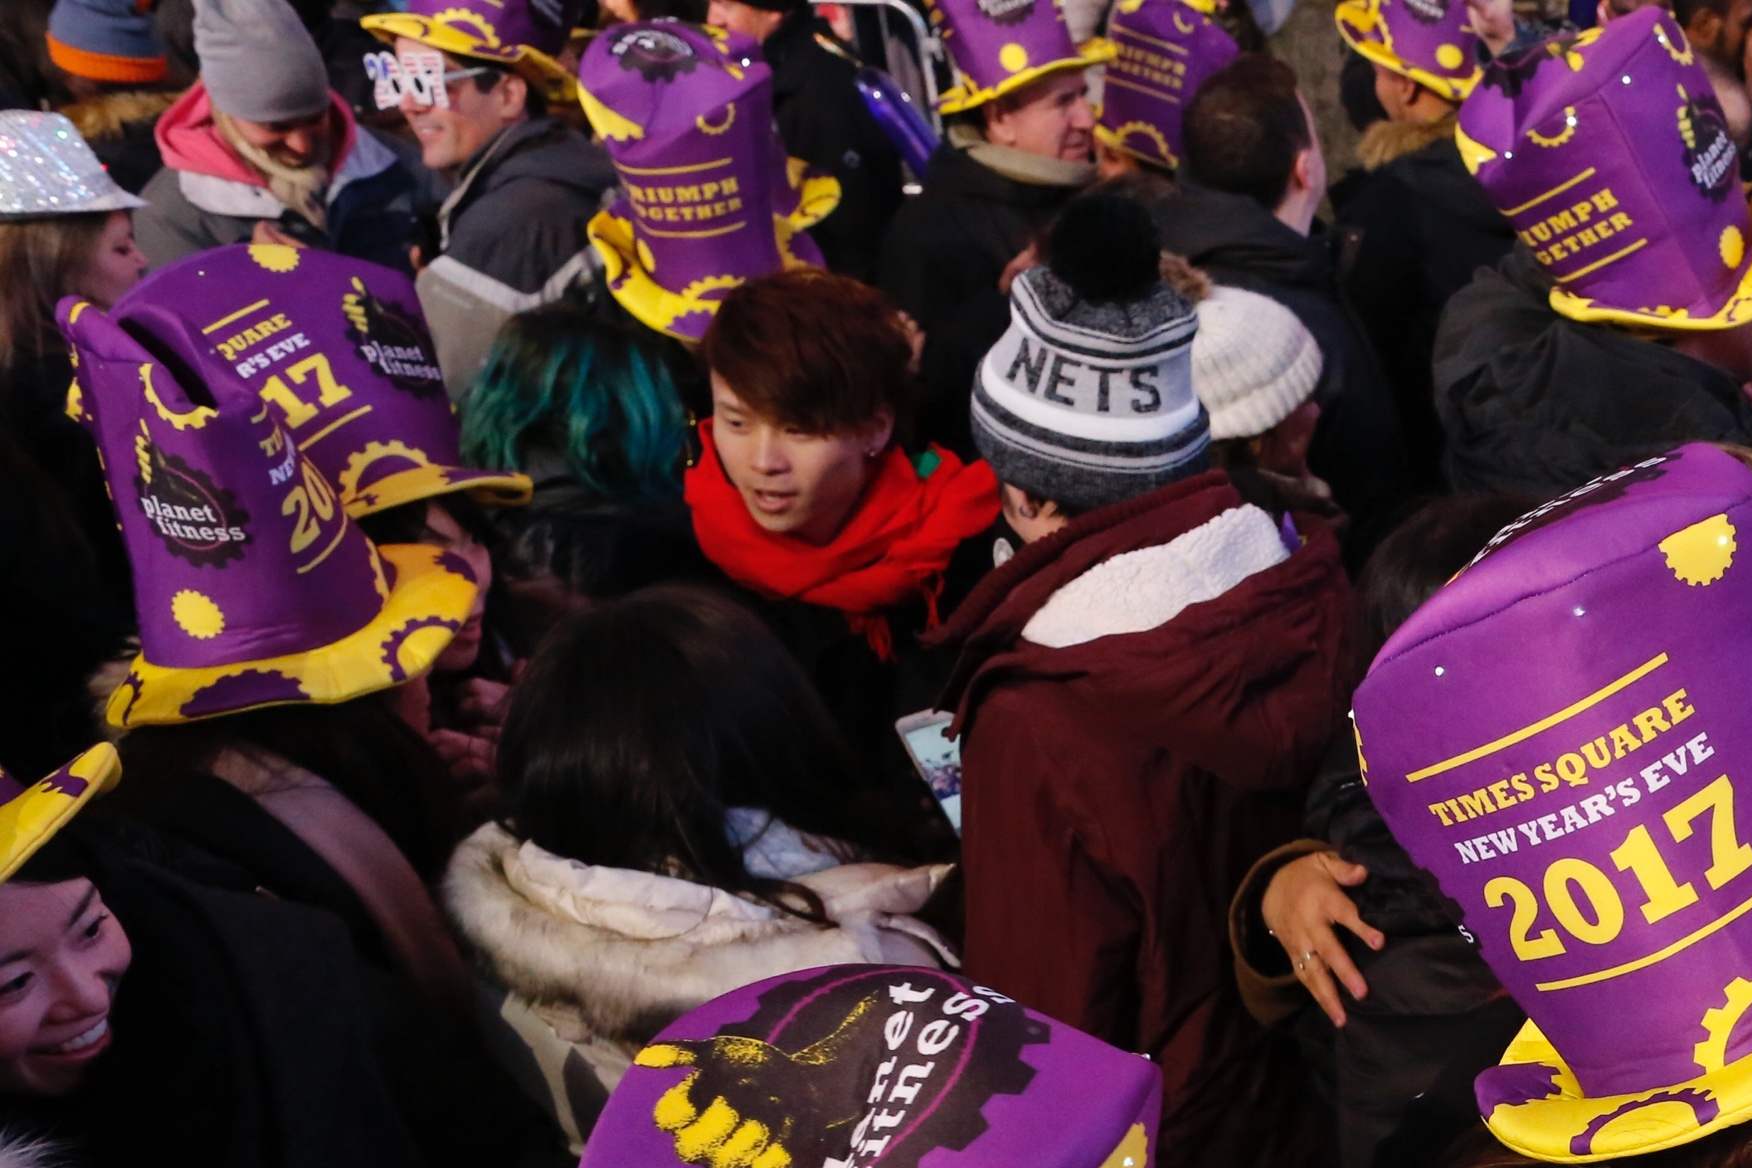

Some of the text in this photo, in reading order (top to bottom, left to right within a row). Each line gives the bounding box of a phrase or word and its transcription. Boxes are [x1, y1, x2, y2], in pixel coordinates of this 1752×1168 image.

[622, 177, 740, 205] RIUMPH
[1518, 187, 1620, 248] IUMPH
[269, 332, 311, 364] EVE
[360, 340, 424, 363] planet
[258, 352, 352, 431] 17
[1006, 337, 1163, 414] NETS
[141, 495, 217, 523] planet
[155, 515, 246, 542] fitness
[1428, 687, 1697, 827] TIMES SQUARE
[1453, 731, 1716, 865] NEW YEAR'S EVE
